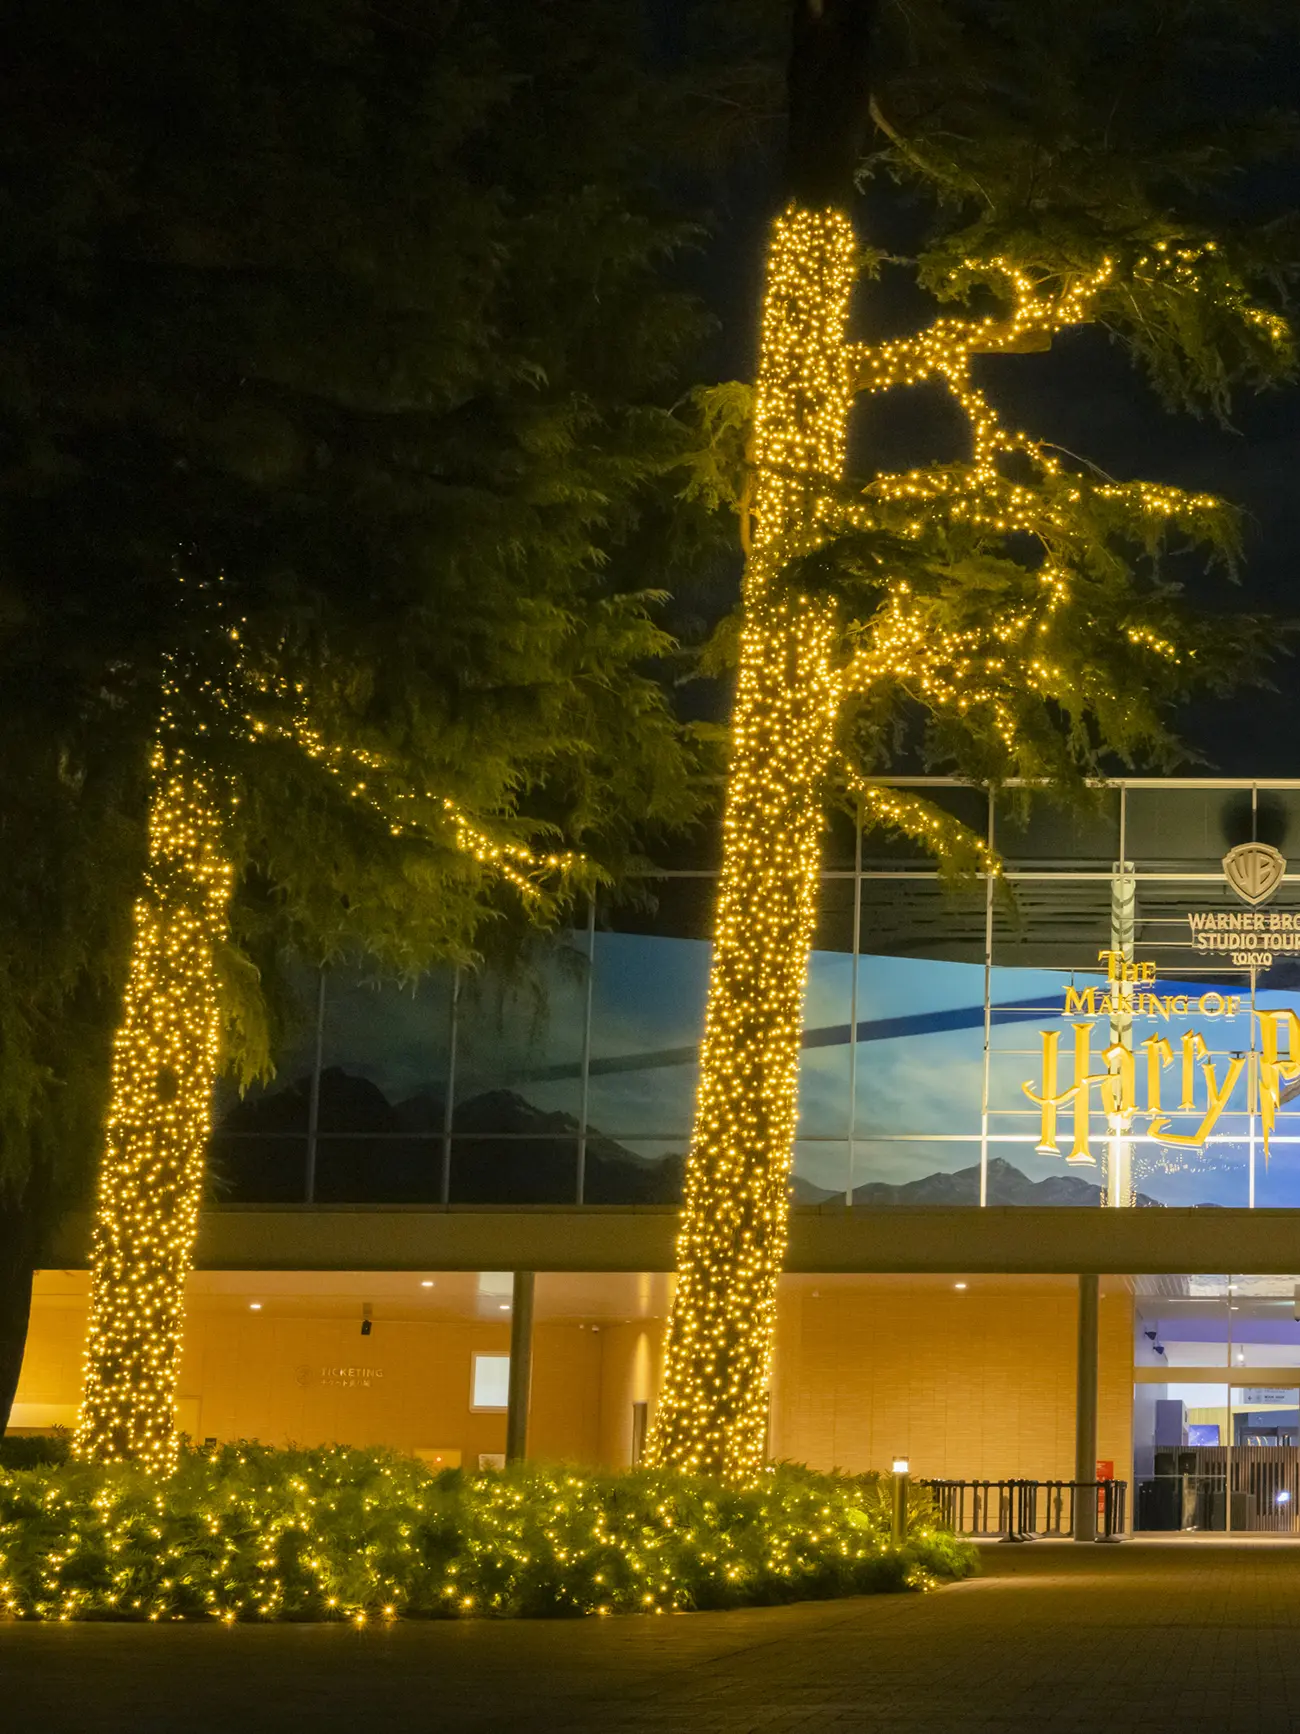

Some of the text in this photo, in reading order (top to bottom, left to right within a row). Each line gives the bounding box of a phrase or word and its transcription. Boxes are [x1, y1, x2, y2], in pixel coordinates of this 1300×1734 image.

[1225, 846, 1284, 900] WB
[1188, 912, 1265, 930] WARNER
[1197, 932, 1258, 950] STUDIO
[1230, 952, 1273, 966] TOKYO
[1022, 1022, 1246, 1165] Harry
[321, 1367, 384, 1378] TICKETING
